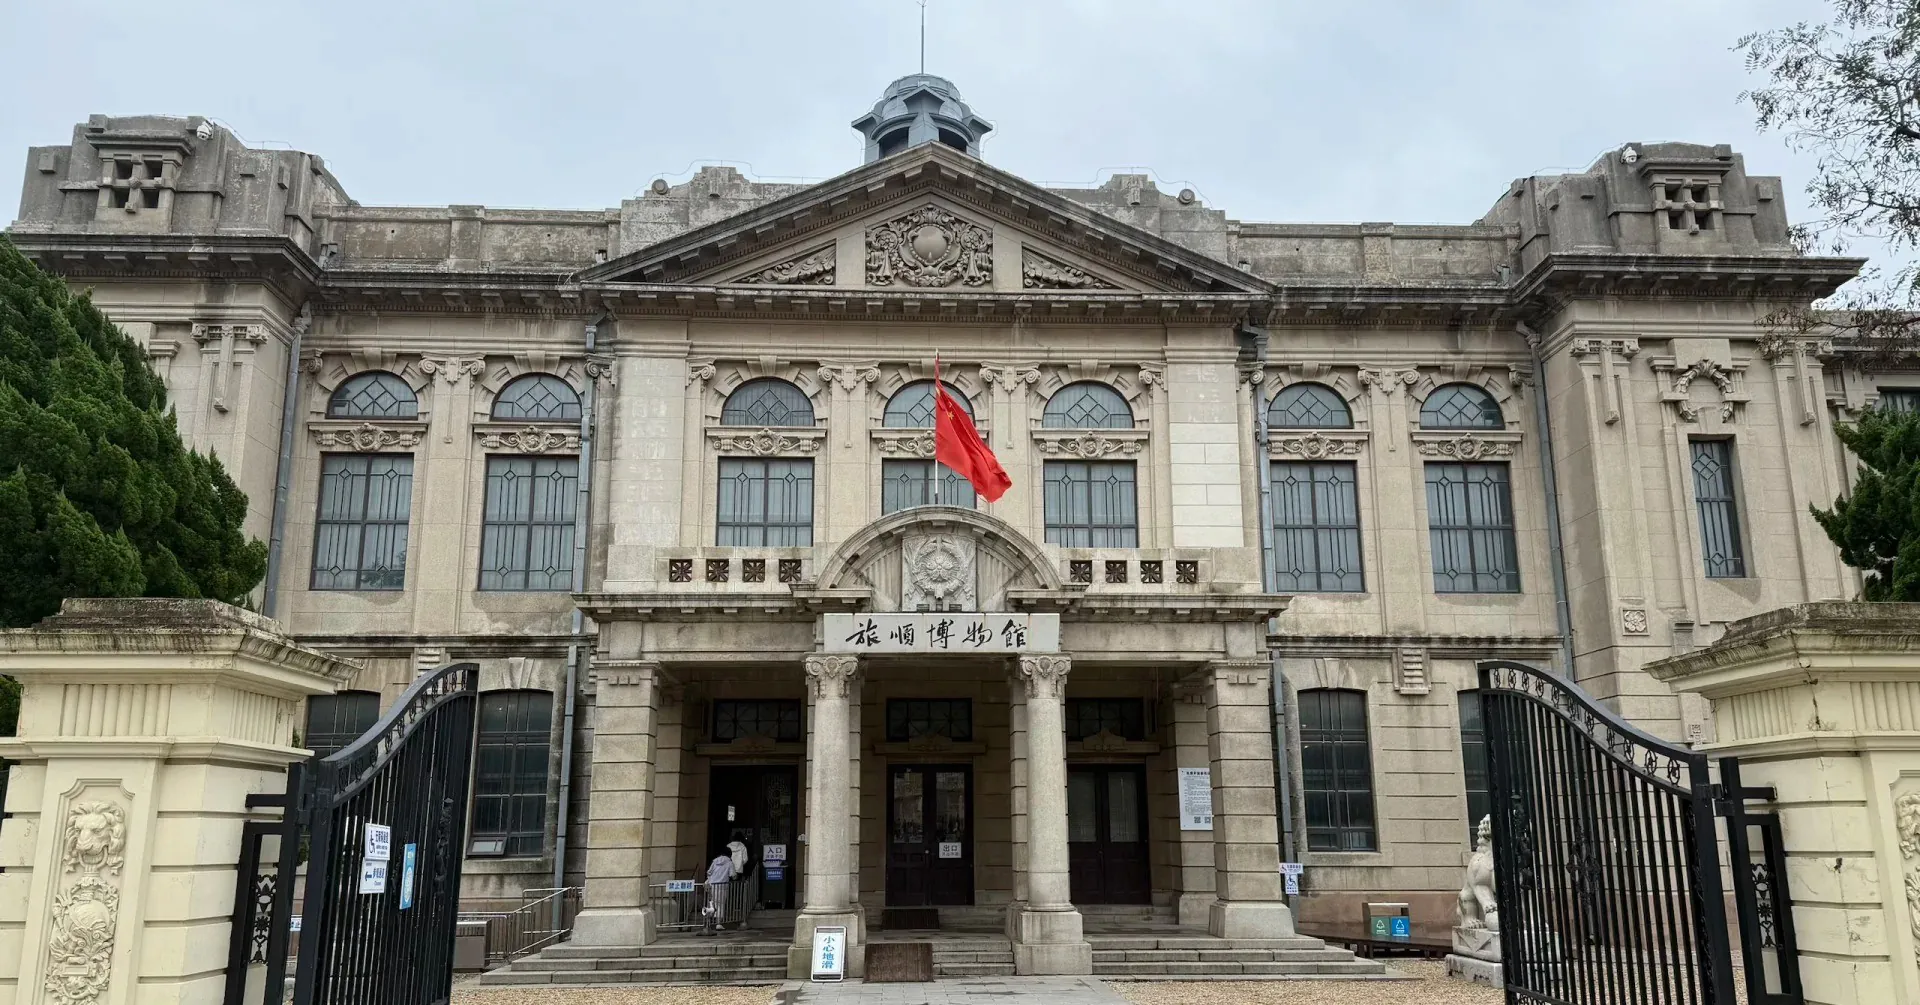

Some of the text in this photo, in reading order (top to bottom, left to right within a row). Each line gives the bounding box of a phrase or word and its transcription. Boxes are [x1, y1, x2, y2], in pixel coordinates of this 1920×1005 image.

[845, 618, 1029, 648] 旅順博物館
[767, 846, 782, 854] 入口
[943, 844, 958, 852] 出口
[821, 935, 835, 969] 小心地滑
